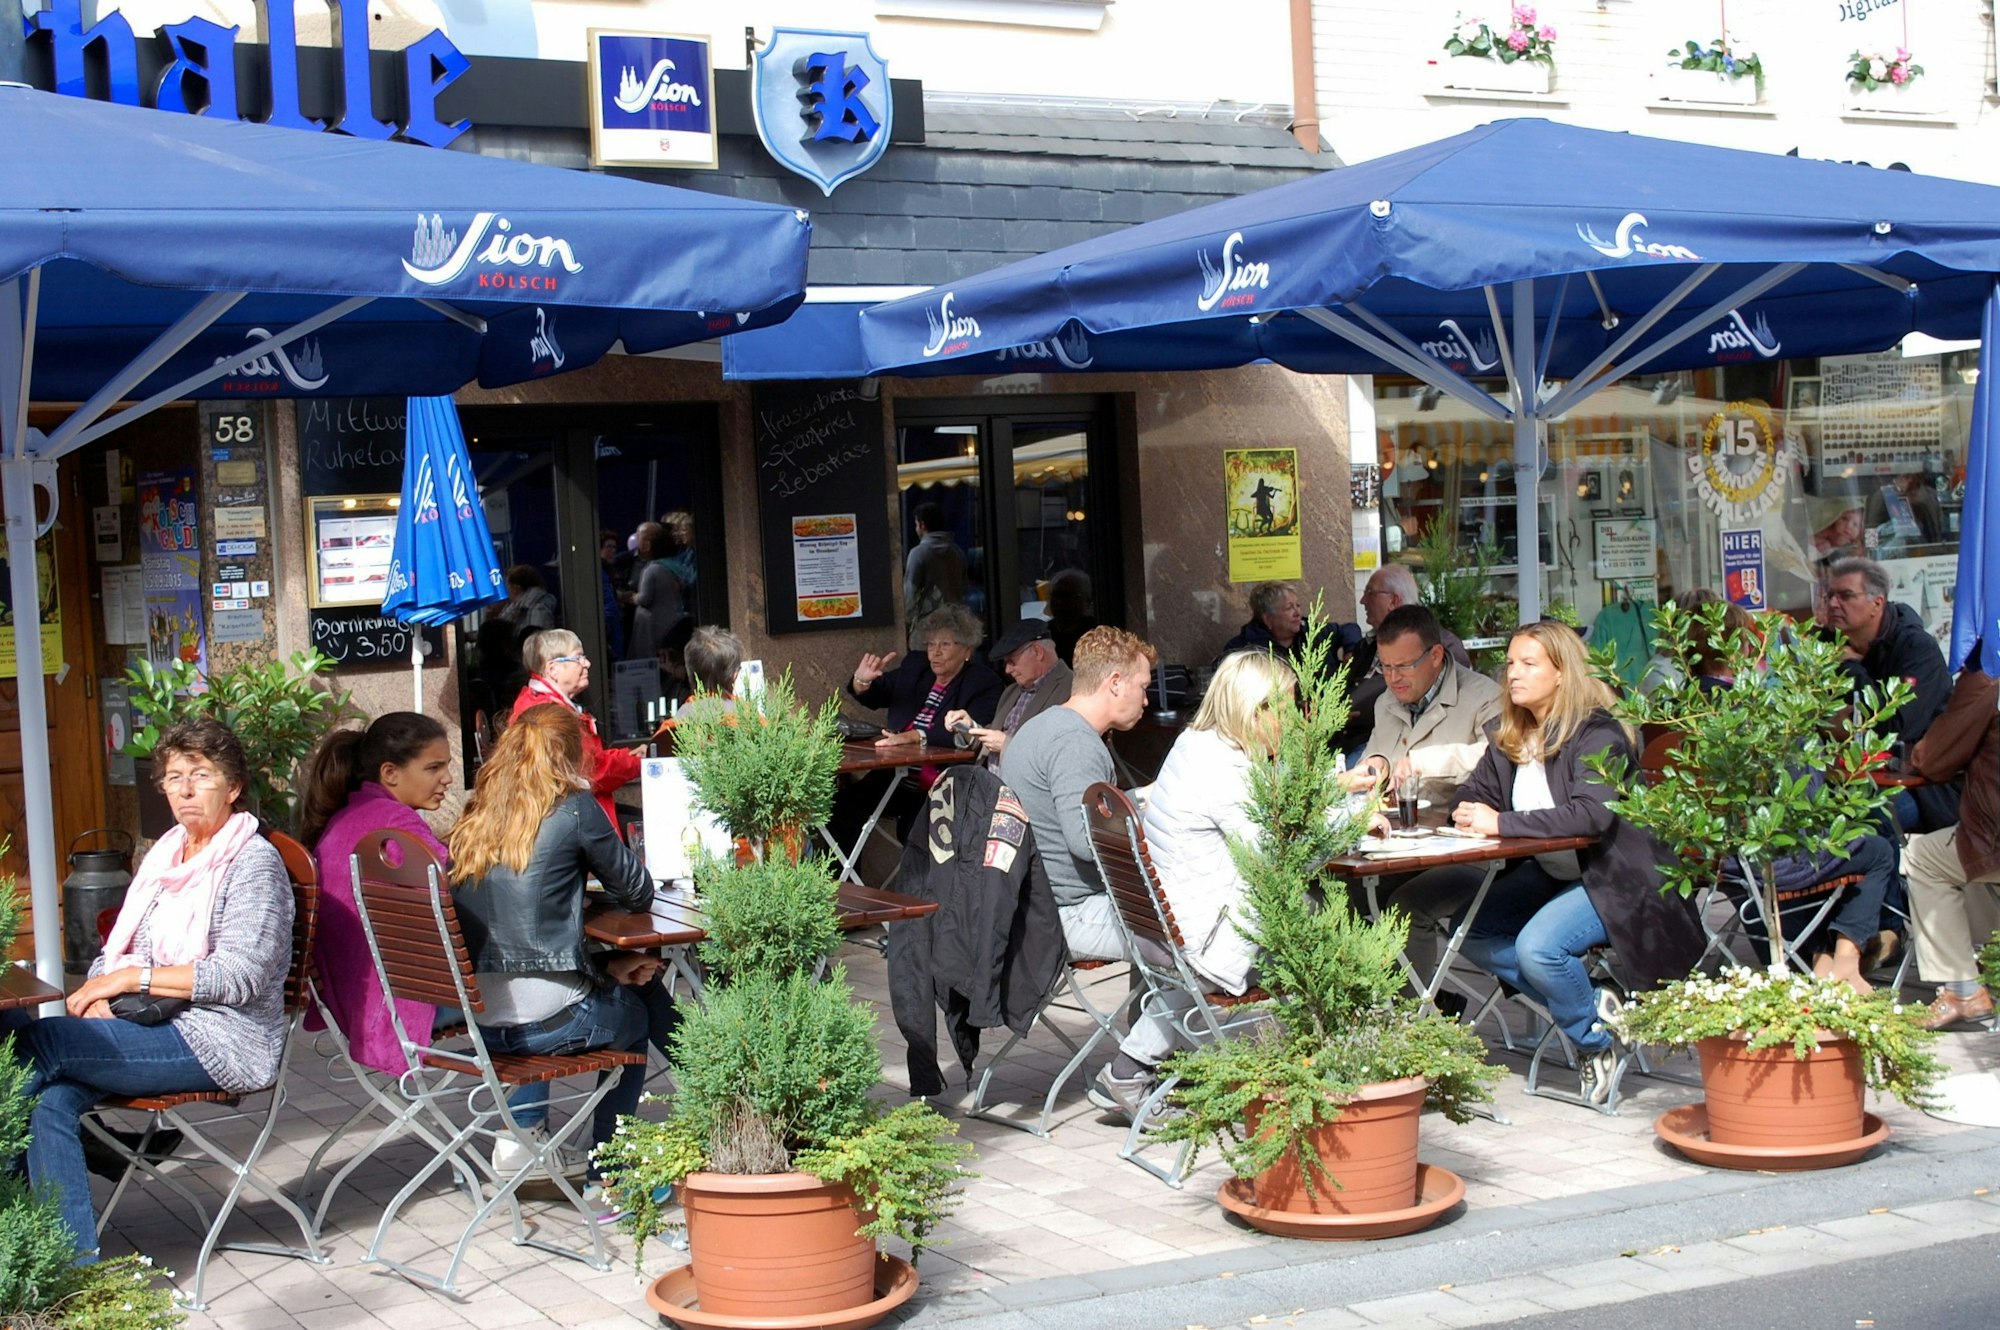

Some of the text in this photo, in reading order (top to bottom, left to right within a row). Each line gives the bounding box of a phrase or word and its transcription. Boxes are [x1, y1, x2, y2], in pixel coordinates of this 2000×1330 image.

[613, 58, 702, 113] Sion
[651, 103, 687, 112] KÖLSCH
[401, 212, 584, 286] Sion
[1590, 212, 1703, 259] Sion
[479, 272, 557, 290] KÖLSCH
[1198, 231, 1269, 311] Sion
[923, 291, 981, 357] Sion
[215, 416, 254, 443] 58
[305, 398, 407, 433] Mittwo
[1717, 419, 1757, 456] 15
[152, 498, 196, 532] KÖLSCH
[160, 522, 199, 551] GAUDI
[1724, 534, 1760, 550] HIER
[357, 632, 405, 657] 3,50
